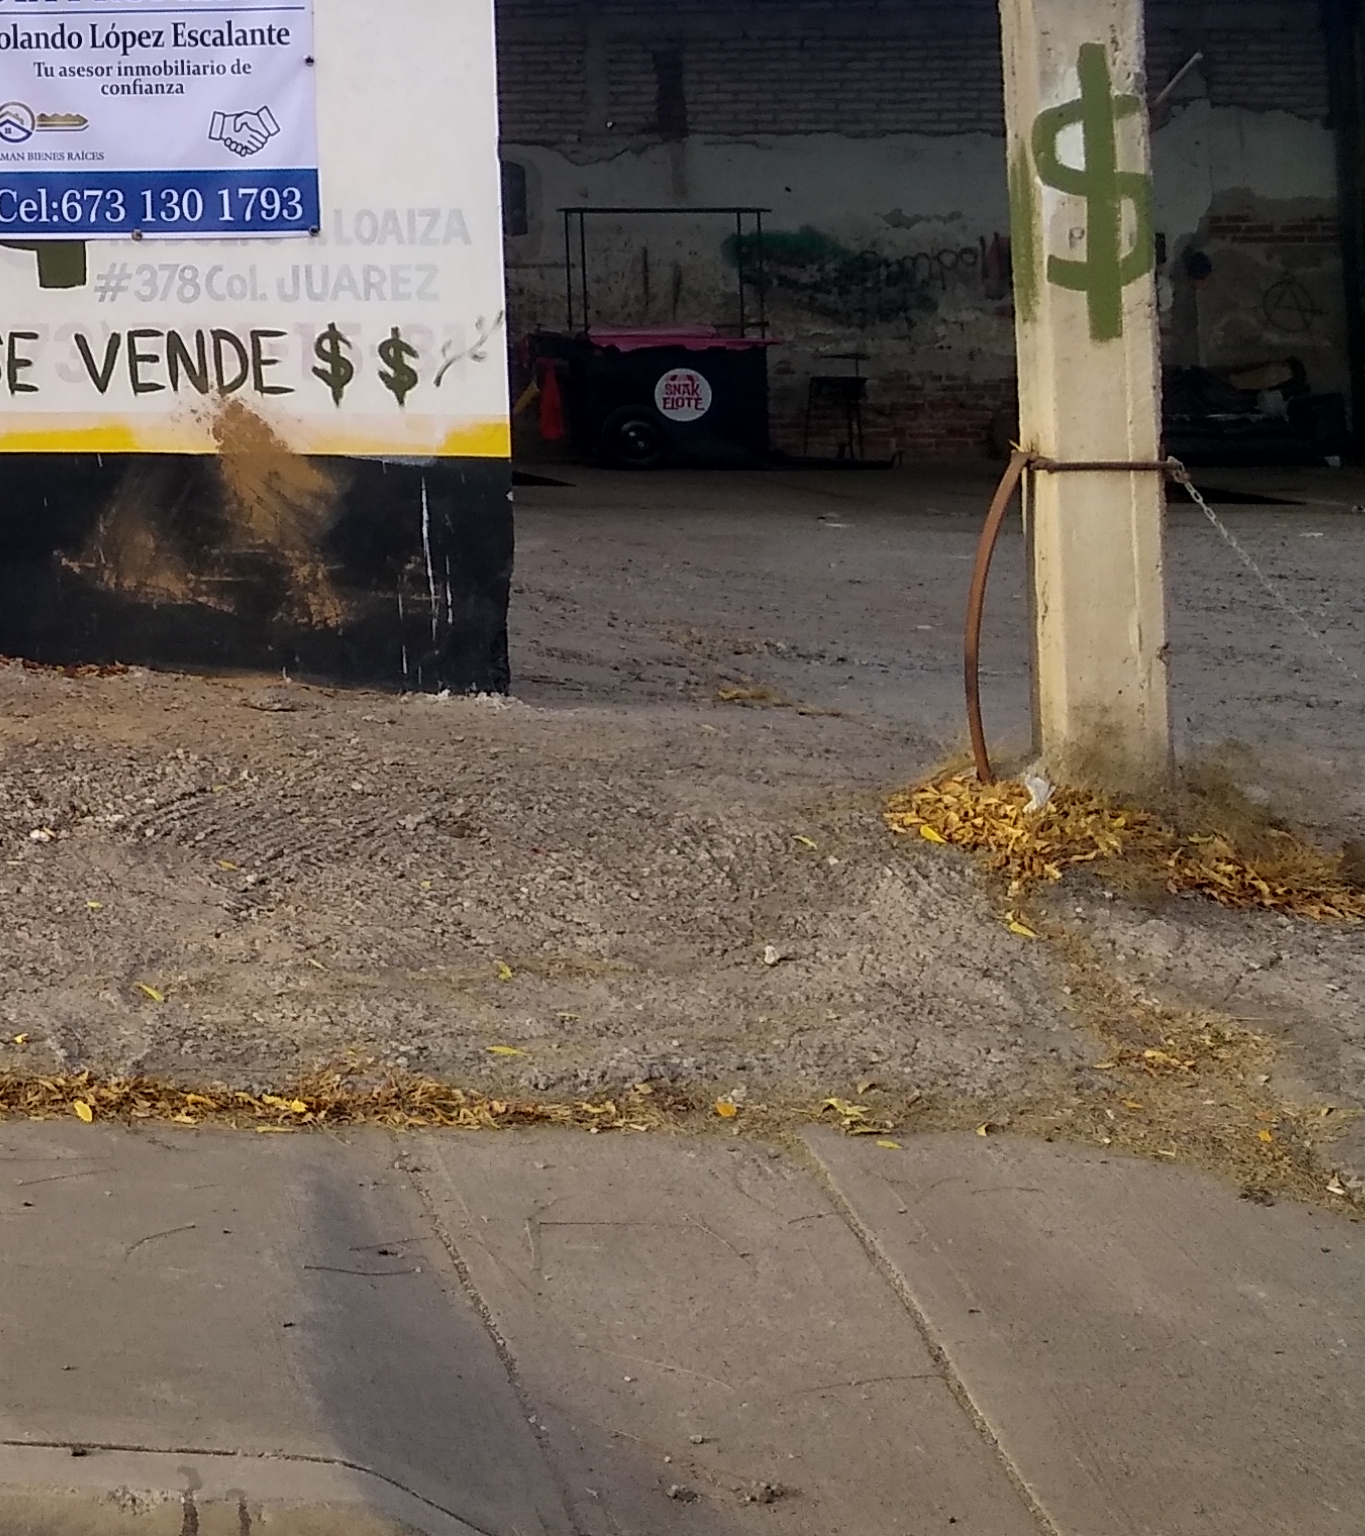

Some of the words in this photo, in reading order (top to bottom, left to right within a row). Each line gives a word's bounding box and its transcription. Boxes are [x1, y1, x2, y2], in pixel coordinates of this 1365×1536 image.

[89, 22, 165, 56] López
[172, 20, 291, 49] Escalante
[33, 62, 55, 78] Tu
[58, 64, 114, 78] asesor
[117, 60, 227, 77] inmobiliario
[230, 58, 253, 75] de
[100, 78, 185, 96] confianza
[27, 151, 65, 162] BIENES
[140, 188, 205, 223] 130
[218, 186, 304, 223] 1793
[333, 207, 473, 247] LOAIZA
[276, 263, 441, 303] JUAREZ
[74, 327, 295, 398] VENDE
